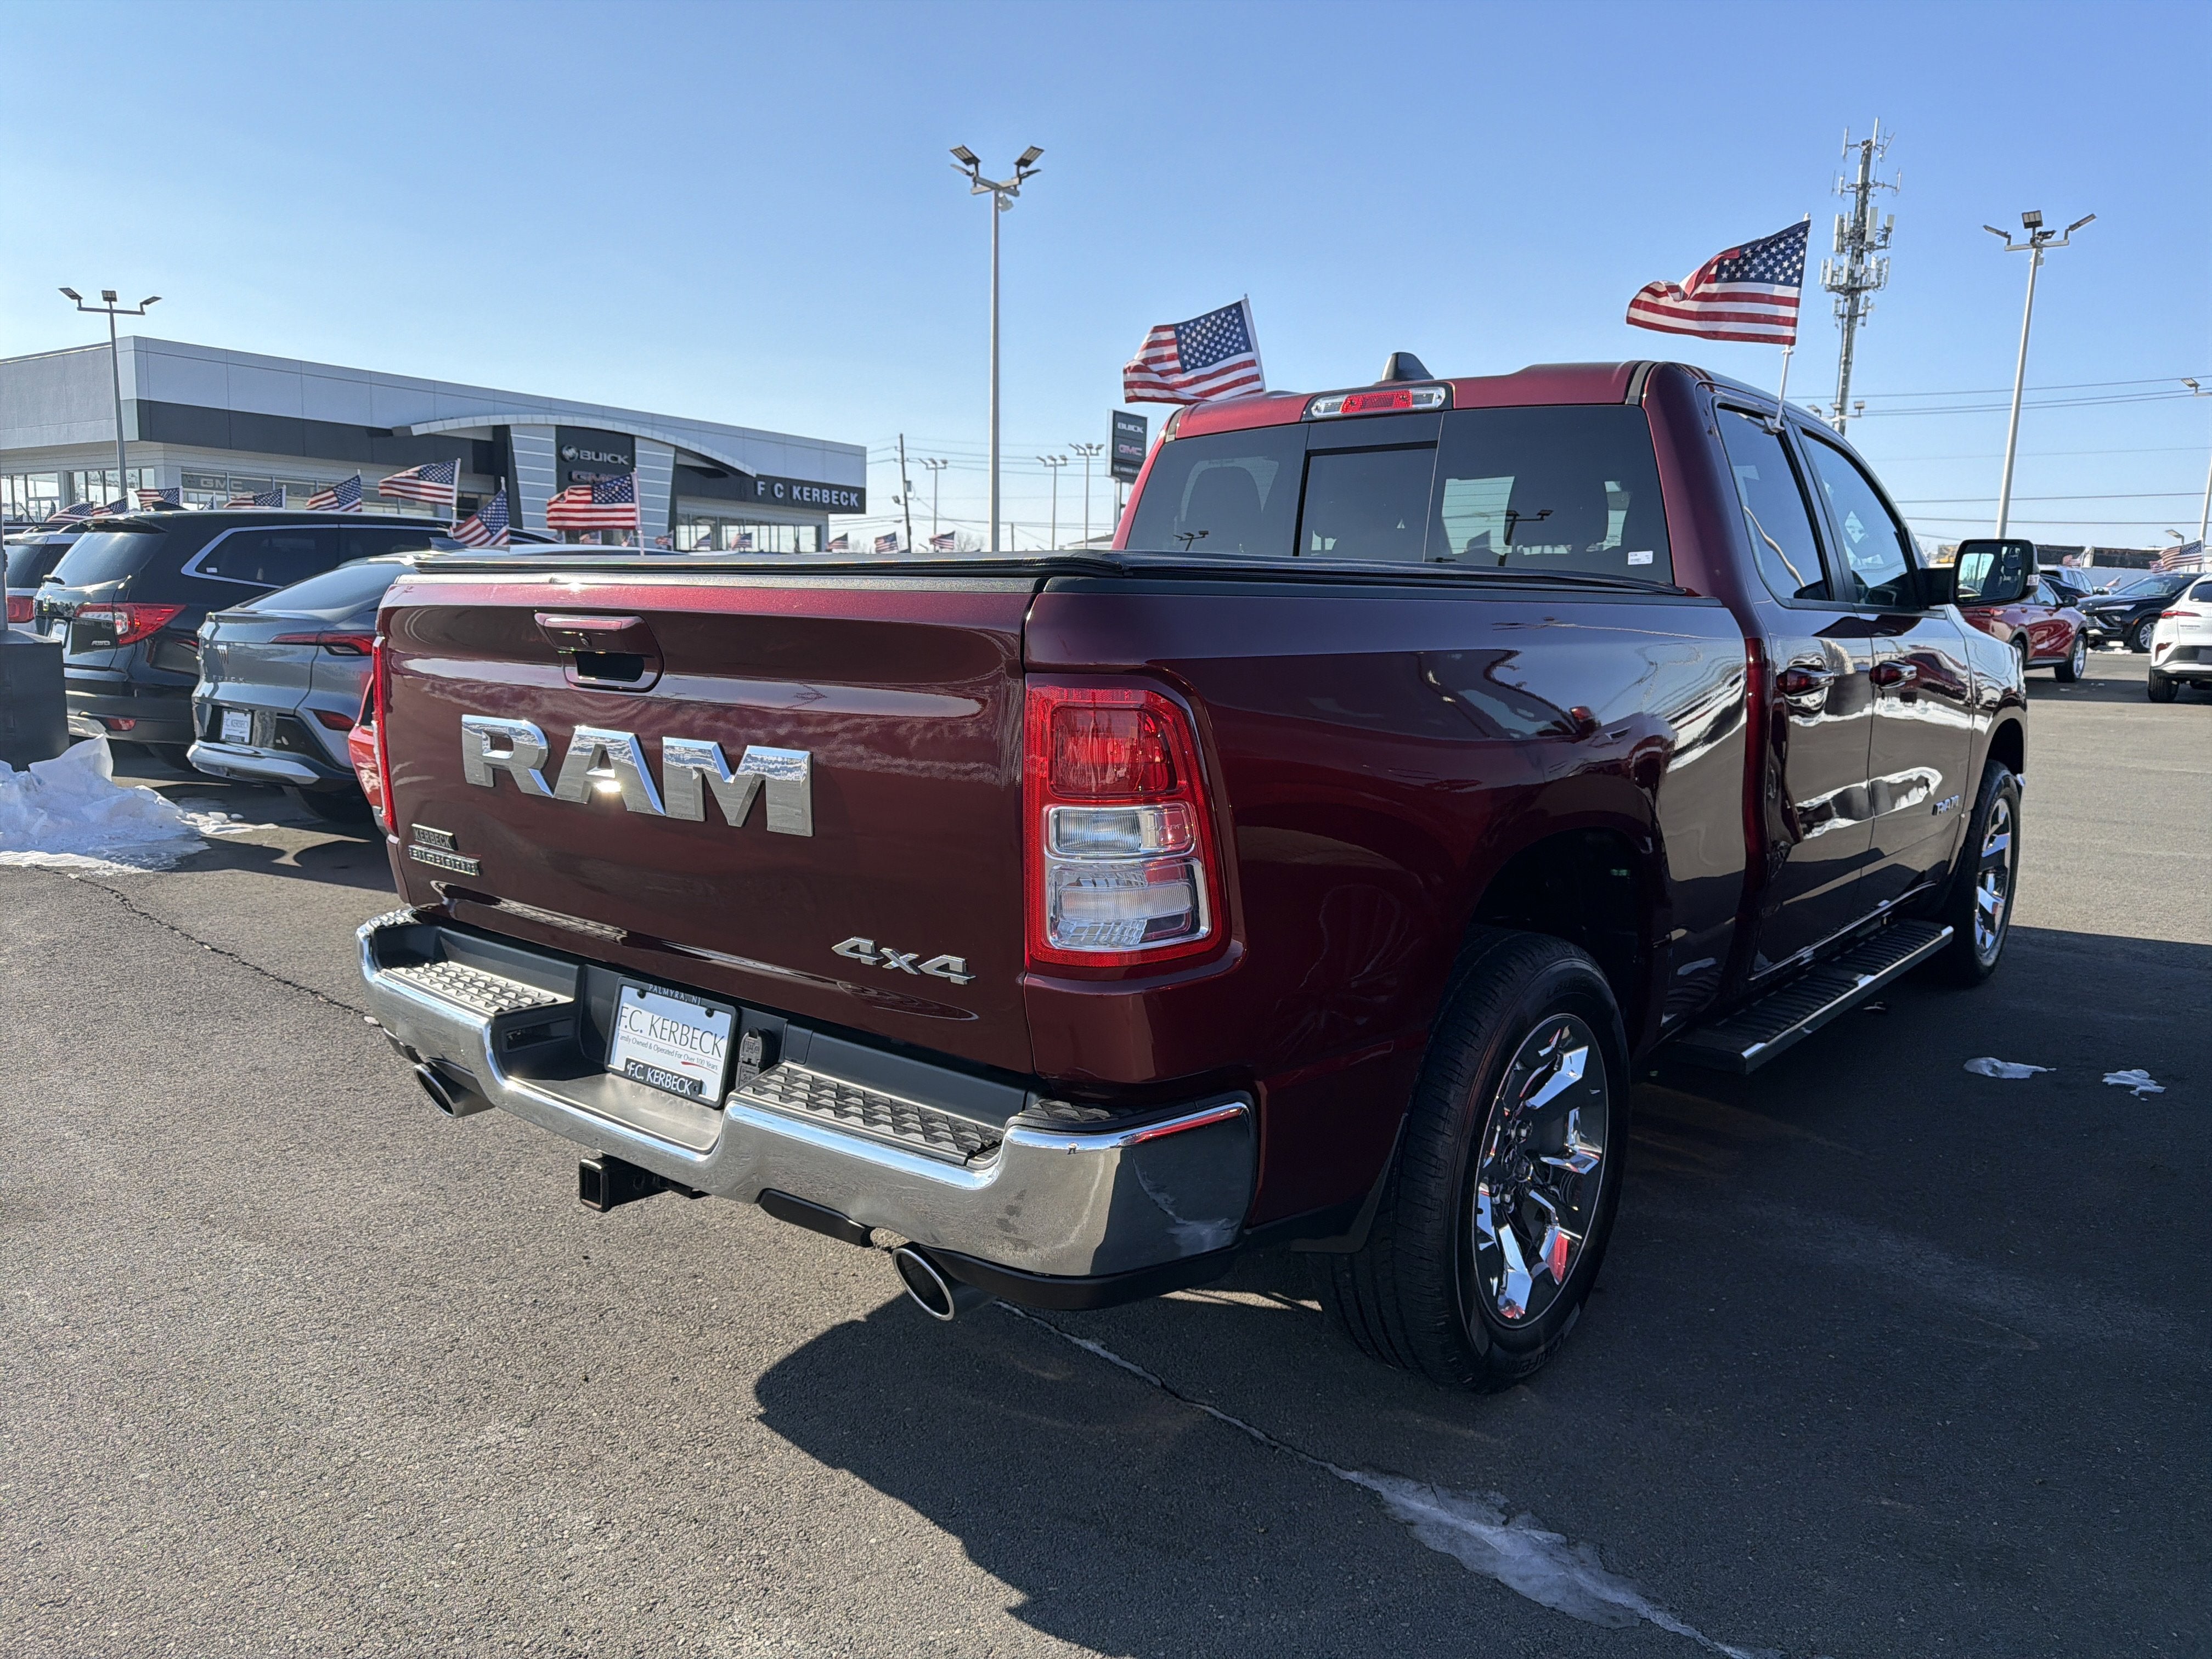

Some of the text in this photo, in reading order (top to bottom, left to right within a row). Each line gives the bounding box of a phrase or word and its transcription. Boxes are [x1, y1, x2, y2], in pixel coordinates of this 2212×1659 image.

[579, 450, 629, 465] BUICK
[1119, 444, 1143, 456] GMC
[200, 478, 243, 490] GMC
[757, 481, 859, 507] F C KERBECK
[461, 714, 814, 837] RAM
[1934, 794, 1960, 816] RAM
[414, 827, 452, 848] KERBECK
[648, 984, 701, 1006] PALMYRA, NJ
[618, 1005, 725, 1058] F.C. KERBECK
[619, 1033, 631, 1045] amily
[632, 1036, 648, 1048] Owned
[648, 1042, 652, 1050] &
[653, 1043, 675, 1057] Operated
[683, 1052, 695, 1063] Over
[696, 1057, 705, 1066] 100
[706, 1060, 718, 1071] Years
[628, 1062, 693, 1096] F.C. KERBECK
